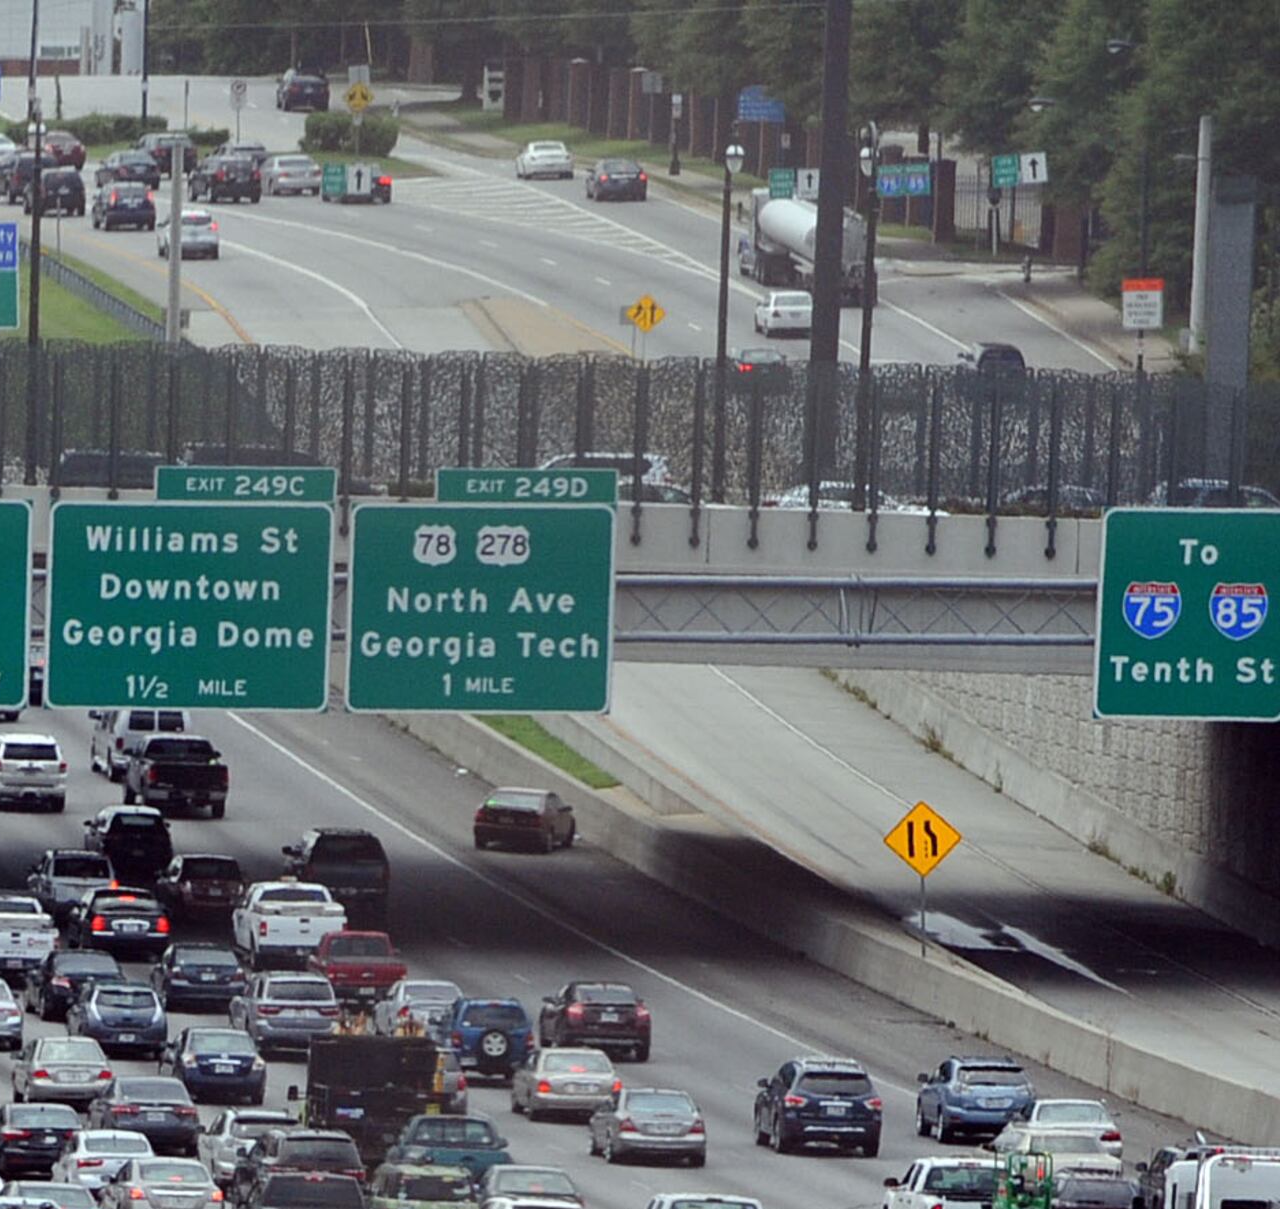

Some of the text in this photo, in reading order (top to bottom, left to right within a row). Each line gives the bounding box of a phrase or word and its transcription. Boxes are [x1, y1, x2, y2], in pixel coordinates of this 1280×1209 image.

[186, 476, 304, 496] EXIT 249C
[467, 477, 587, 498] EXIT 249D
[86, 525, 298, 553] Williams St
[418, 534, 528, 556] 78 278
[100, 573, 280, 600] Downtown
[387, 587, 576, 614] North Ave
[1129, 596, 1263, 629] 75 85
[63, 619, 314, 654] Georgia Dome
[360, 631, 599, 665] Georgia Tech
[1109, 655, 1275, 684] Tenth St
[198, 679, 247, 696] MILE
[442, 673, 515, 696] 1 MILE
